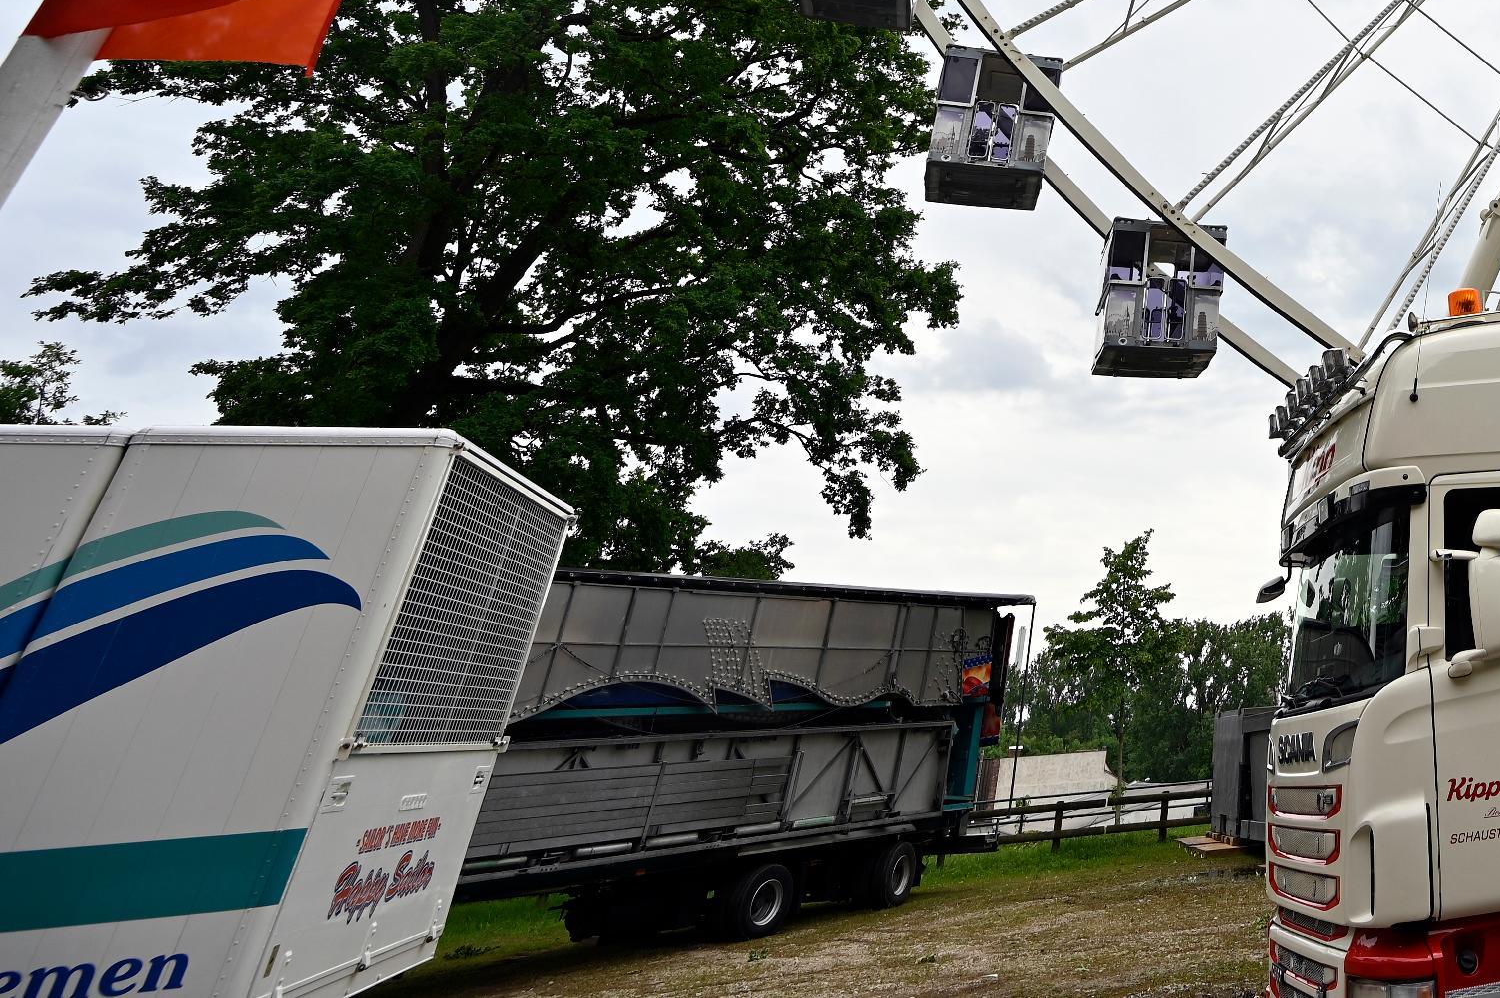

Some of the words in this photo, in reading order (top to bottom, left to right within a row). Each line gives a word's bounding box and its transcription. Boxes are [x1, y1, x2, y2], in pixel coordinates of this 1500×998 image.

[1278, 732, 1317, 764] SCANIA
[1447, 776, 1500, 802] Kipp
[327, 861, 389, 925] Happy
[385, 849, 435, 903] Sailor
